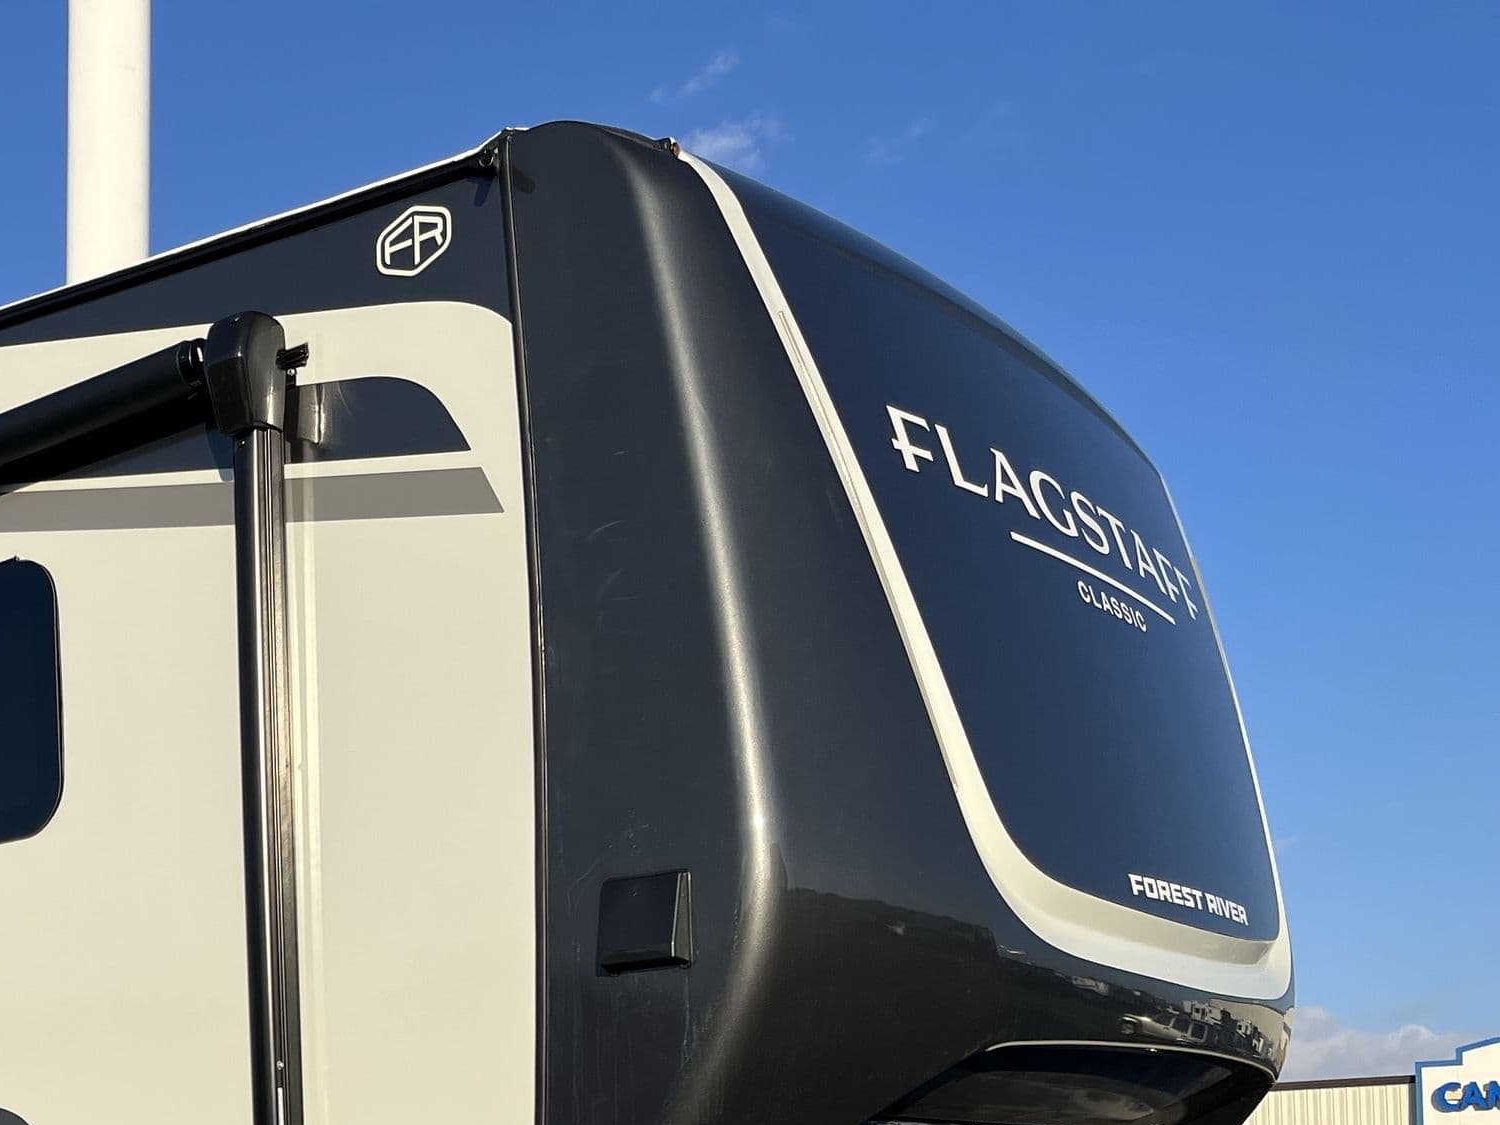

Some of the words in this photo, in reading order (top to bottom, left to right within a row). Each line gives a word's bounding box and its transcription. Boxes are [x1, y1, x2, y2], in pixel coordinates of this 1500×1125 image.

[886, 405, 1198, 620] FLAGSTAFF
[1078, 580, 1147, 632] CLASSIC
[1128, 873, 1202, 910] FOREST
[1204, 892, 1249, 926] RIVER
